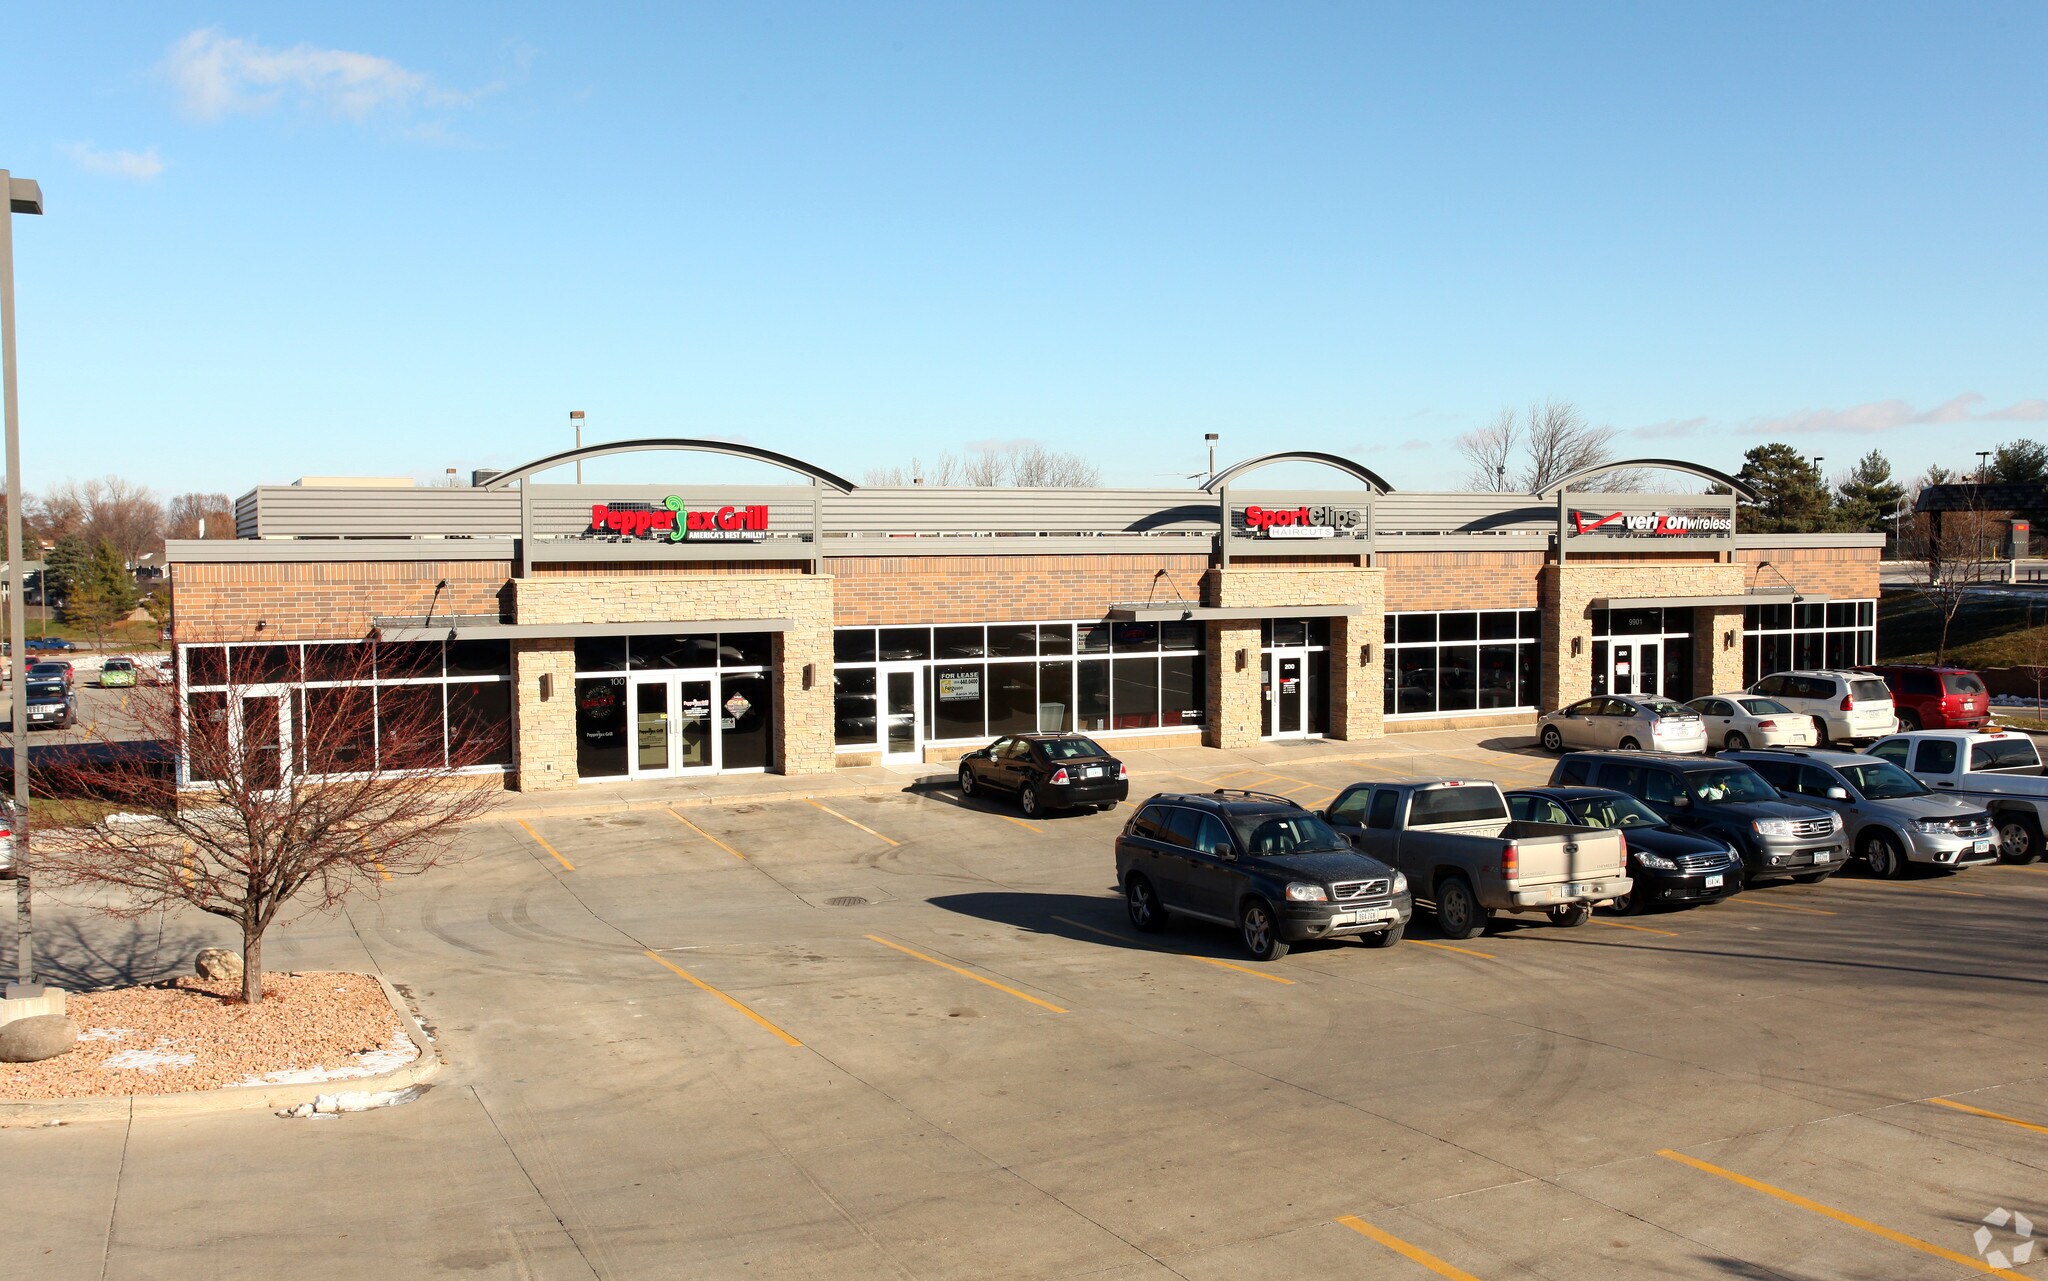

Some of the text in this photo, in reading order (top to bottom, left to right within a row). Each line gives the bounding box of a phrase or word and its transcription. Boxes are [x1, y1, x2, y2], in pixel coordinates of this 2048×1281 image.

[717, 505, 769, 530] Grill
[689, 531, 765, 539] AMERICA'S BEST PHILLY!
[1272, 528, 1332, 536] HAIRCUTS
[1629, 618, 1643, 626] 9901
[610, 677, 625, 686] 100
